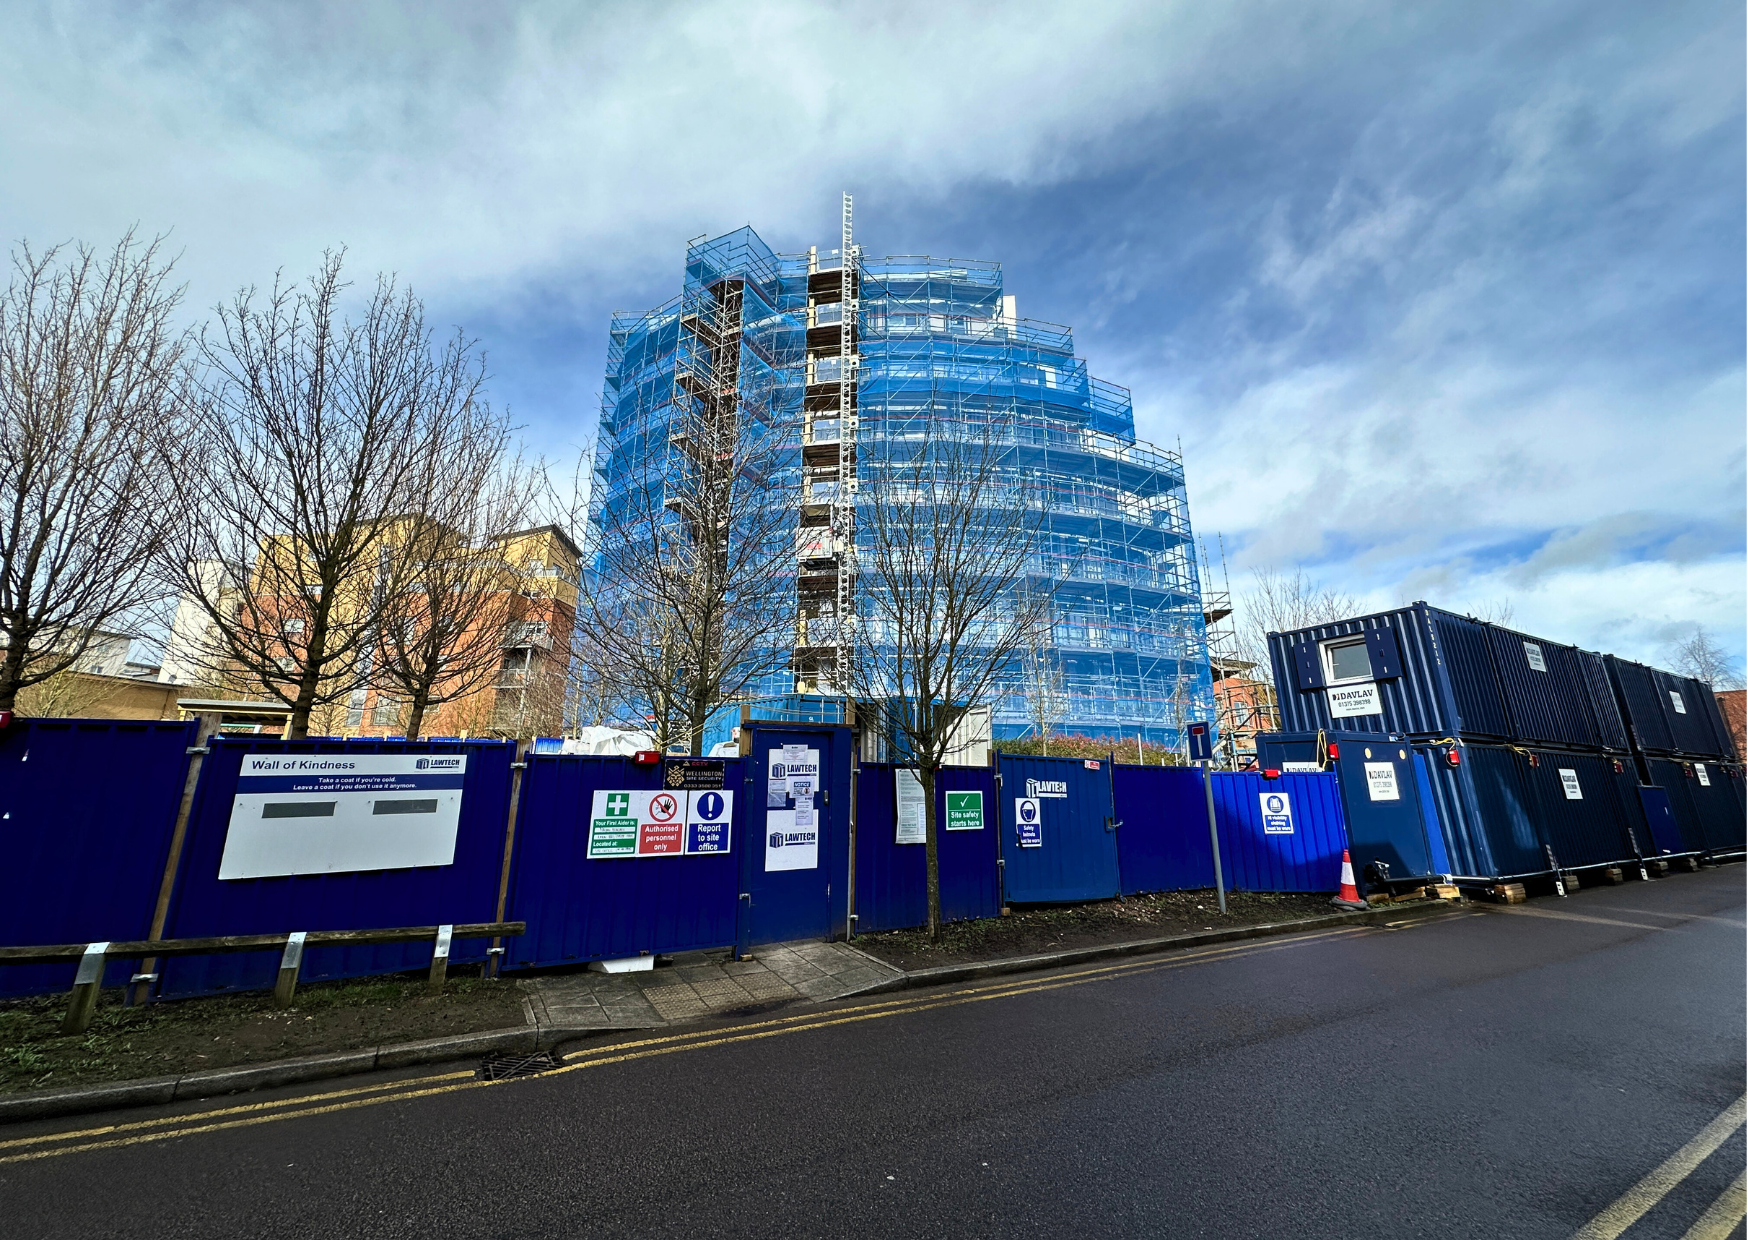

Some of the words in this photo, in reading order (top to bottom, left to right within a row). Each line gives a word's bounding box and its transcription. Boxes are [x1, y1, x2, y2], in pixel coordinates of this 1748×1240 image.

[1340, 689, 1373, 700] DAVLAV
[252, 761, 279, 769] Wall
[283, 761, 296, 769] of
[299, 761, 355, 770] Kindness
[787, 764, 817, 773] LAWTECH
[951, 811, 961, 819] Site
[963, 810, 979, 819] safety
[645, 824, 679, 833] Authorised
[697, 824, 721, 834] Report
[645, 834, 677, 843] personnel
[698, 834, 705, 842] to
[706, 833, 720, 842] site
[785, 832, 815, 842] LAWTECH
[653, 843, 667, 851] only
[698, 843, 718, 851] office
